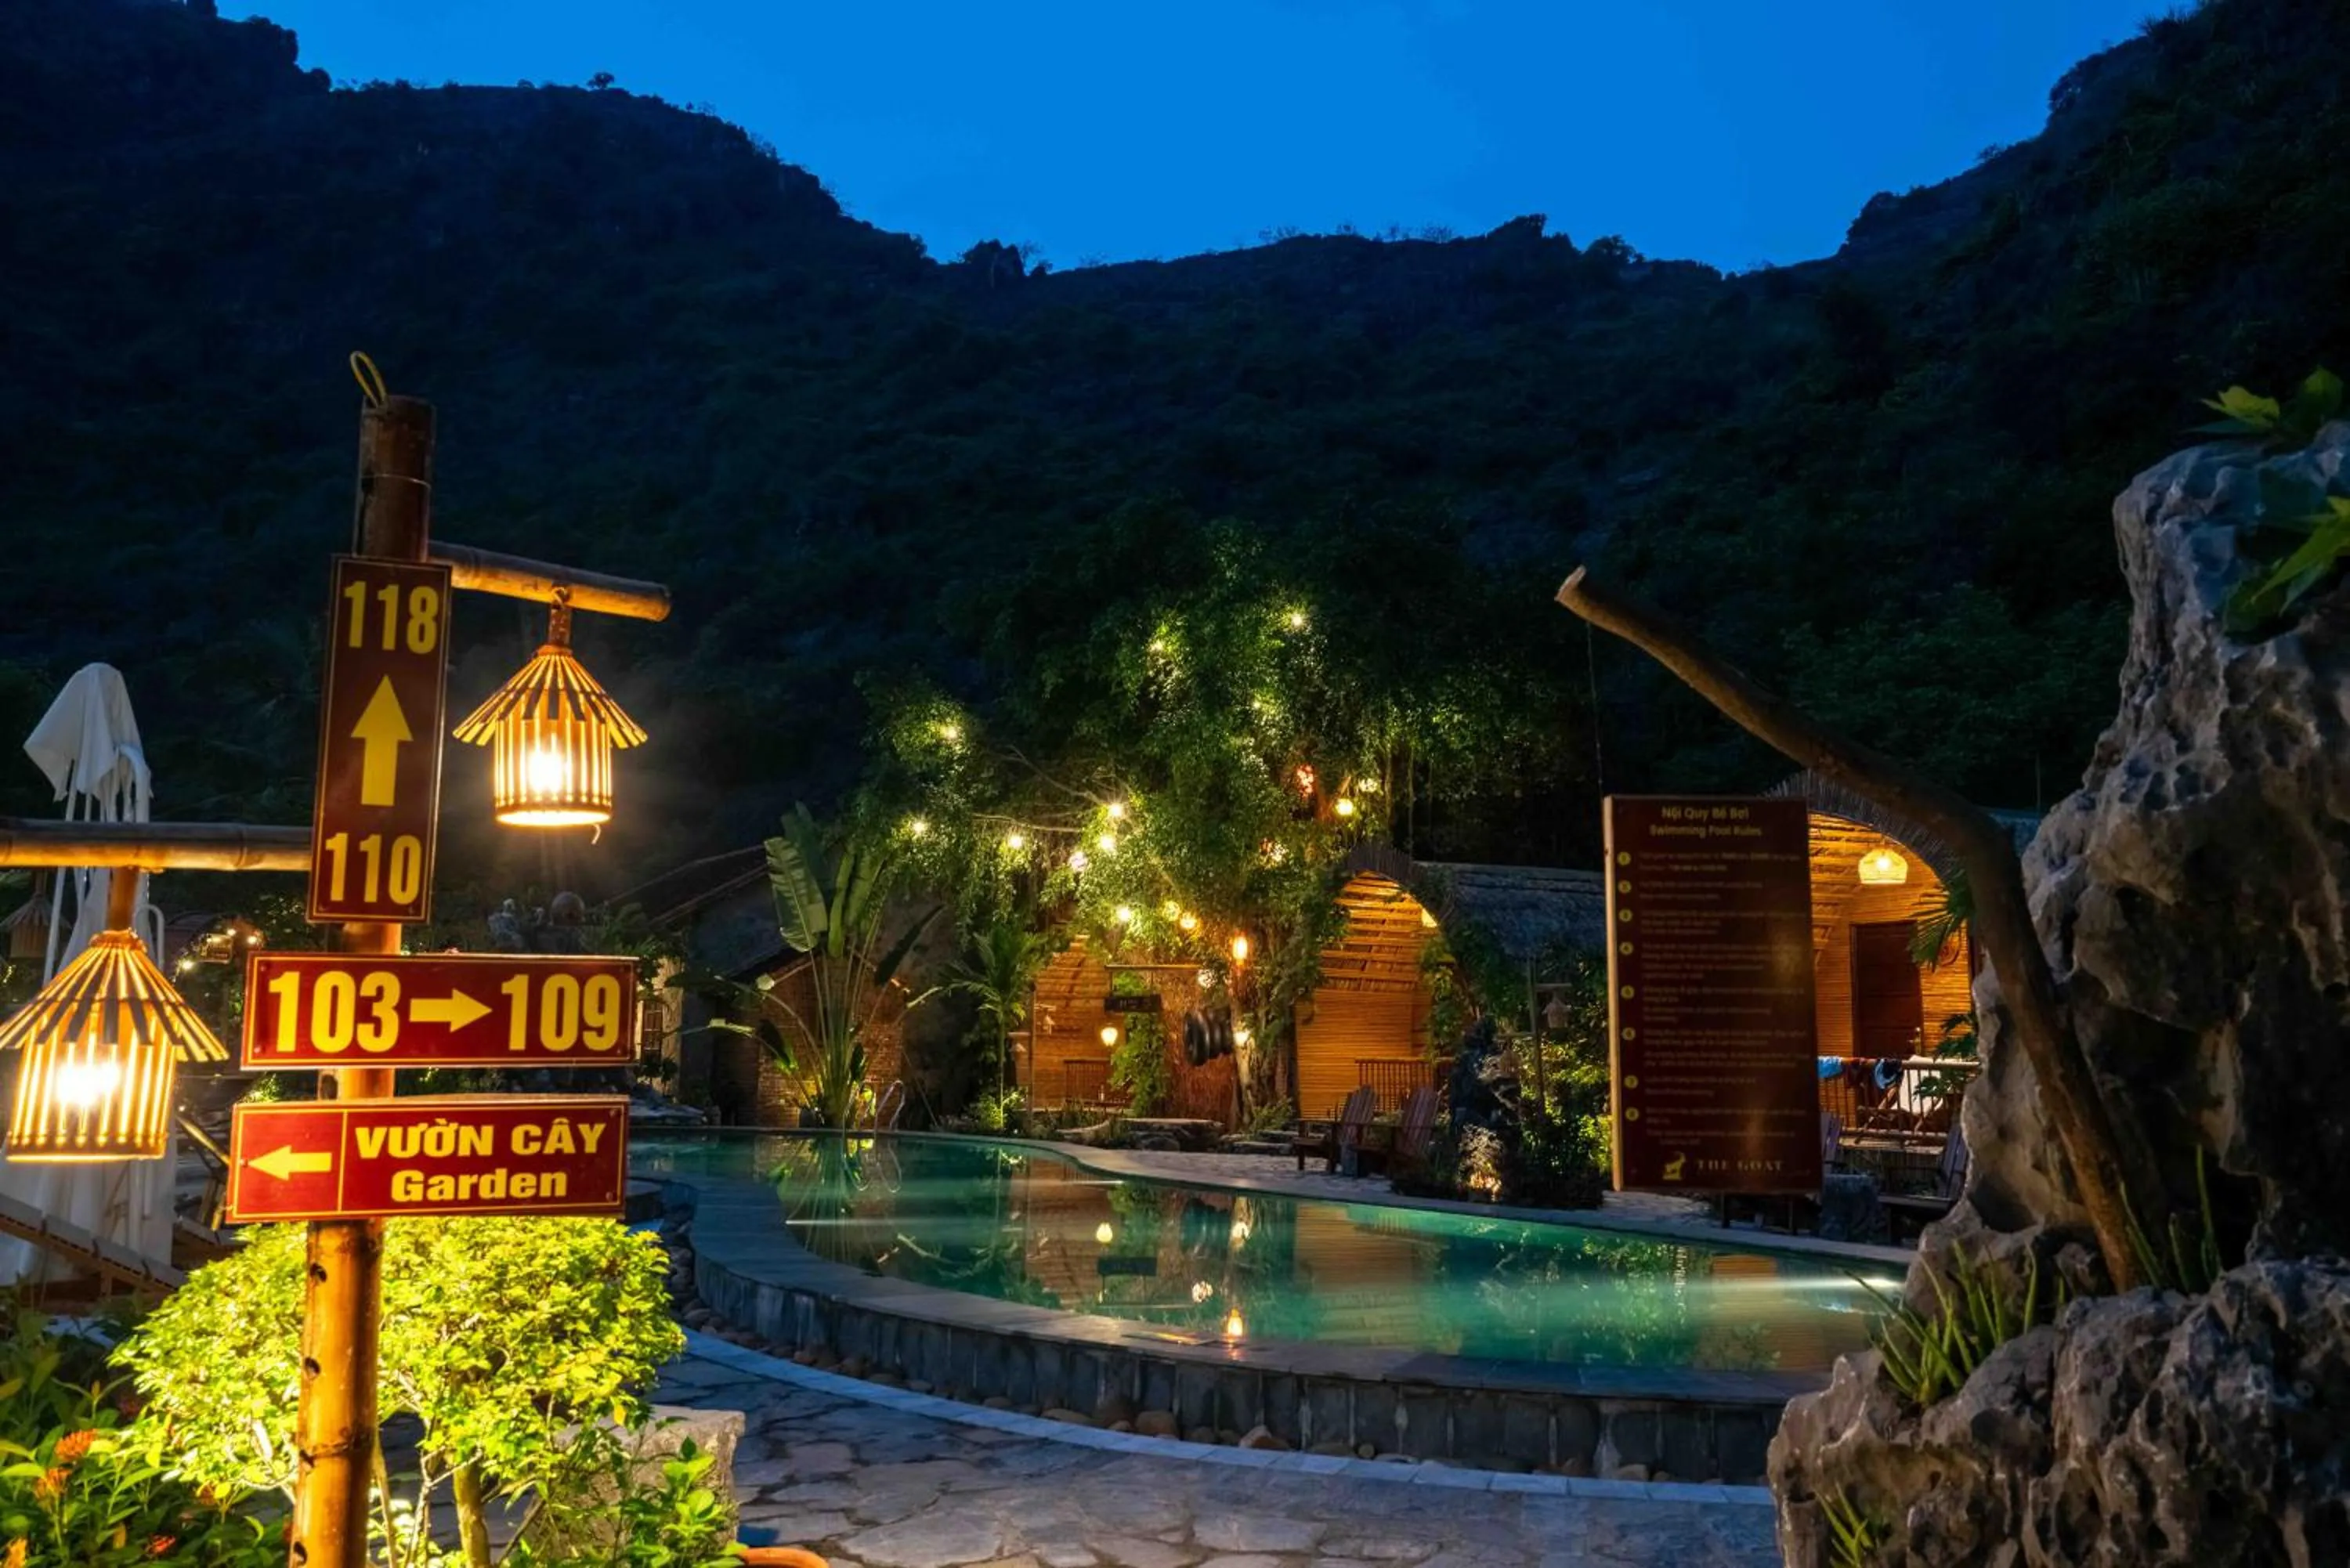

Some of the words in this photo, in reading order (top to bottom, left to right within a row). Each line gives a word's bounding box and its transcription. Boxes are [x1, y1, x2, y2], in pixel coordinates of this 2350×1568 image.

[345, 580, 439, 654] 118
[1650, 824, 1707, 839] Swimming
[1708, 825, 1732, 836] Pool
[325, 832, 422, 905] 110
[268, 970, 401, 1053] 103
[501, 973, 621, 1051] 109
[355, 1118, 494, 1159] VƯỜN
[511, 1117, 606, 1155] CÂY
[391, 1168, 568, 1203] Garden
[1736, 1159, 1784, 1171] GOAT
